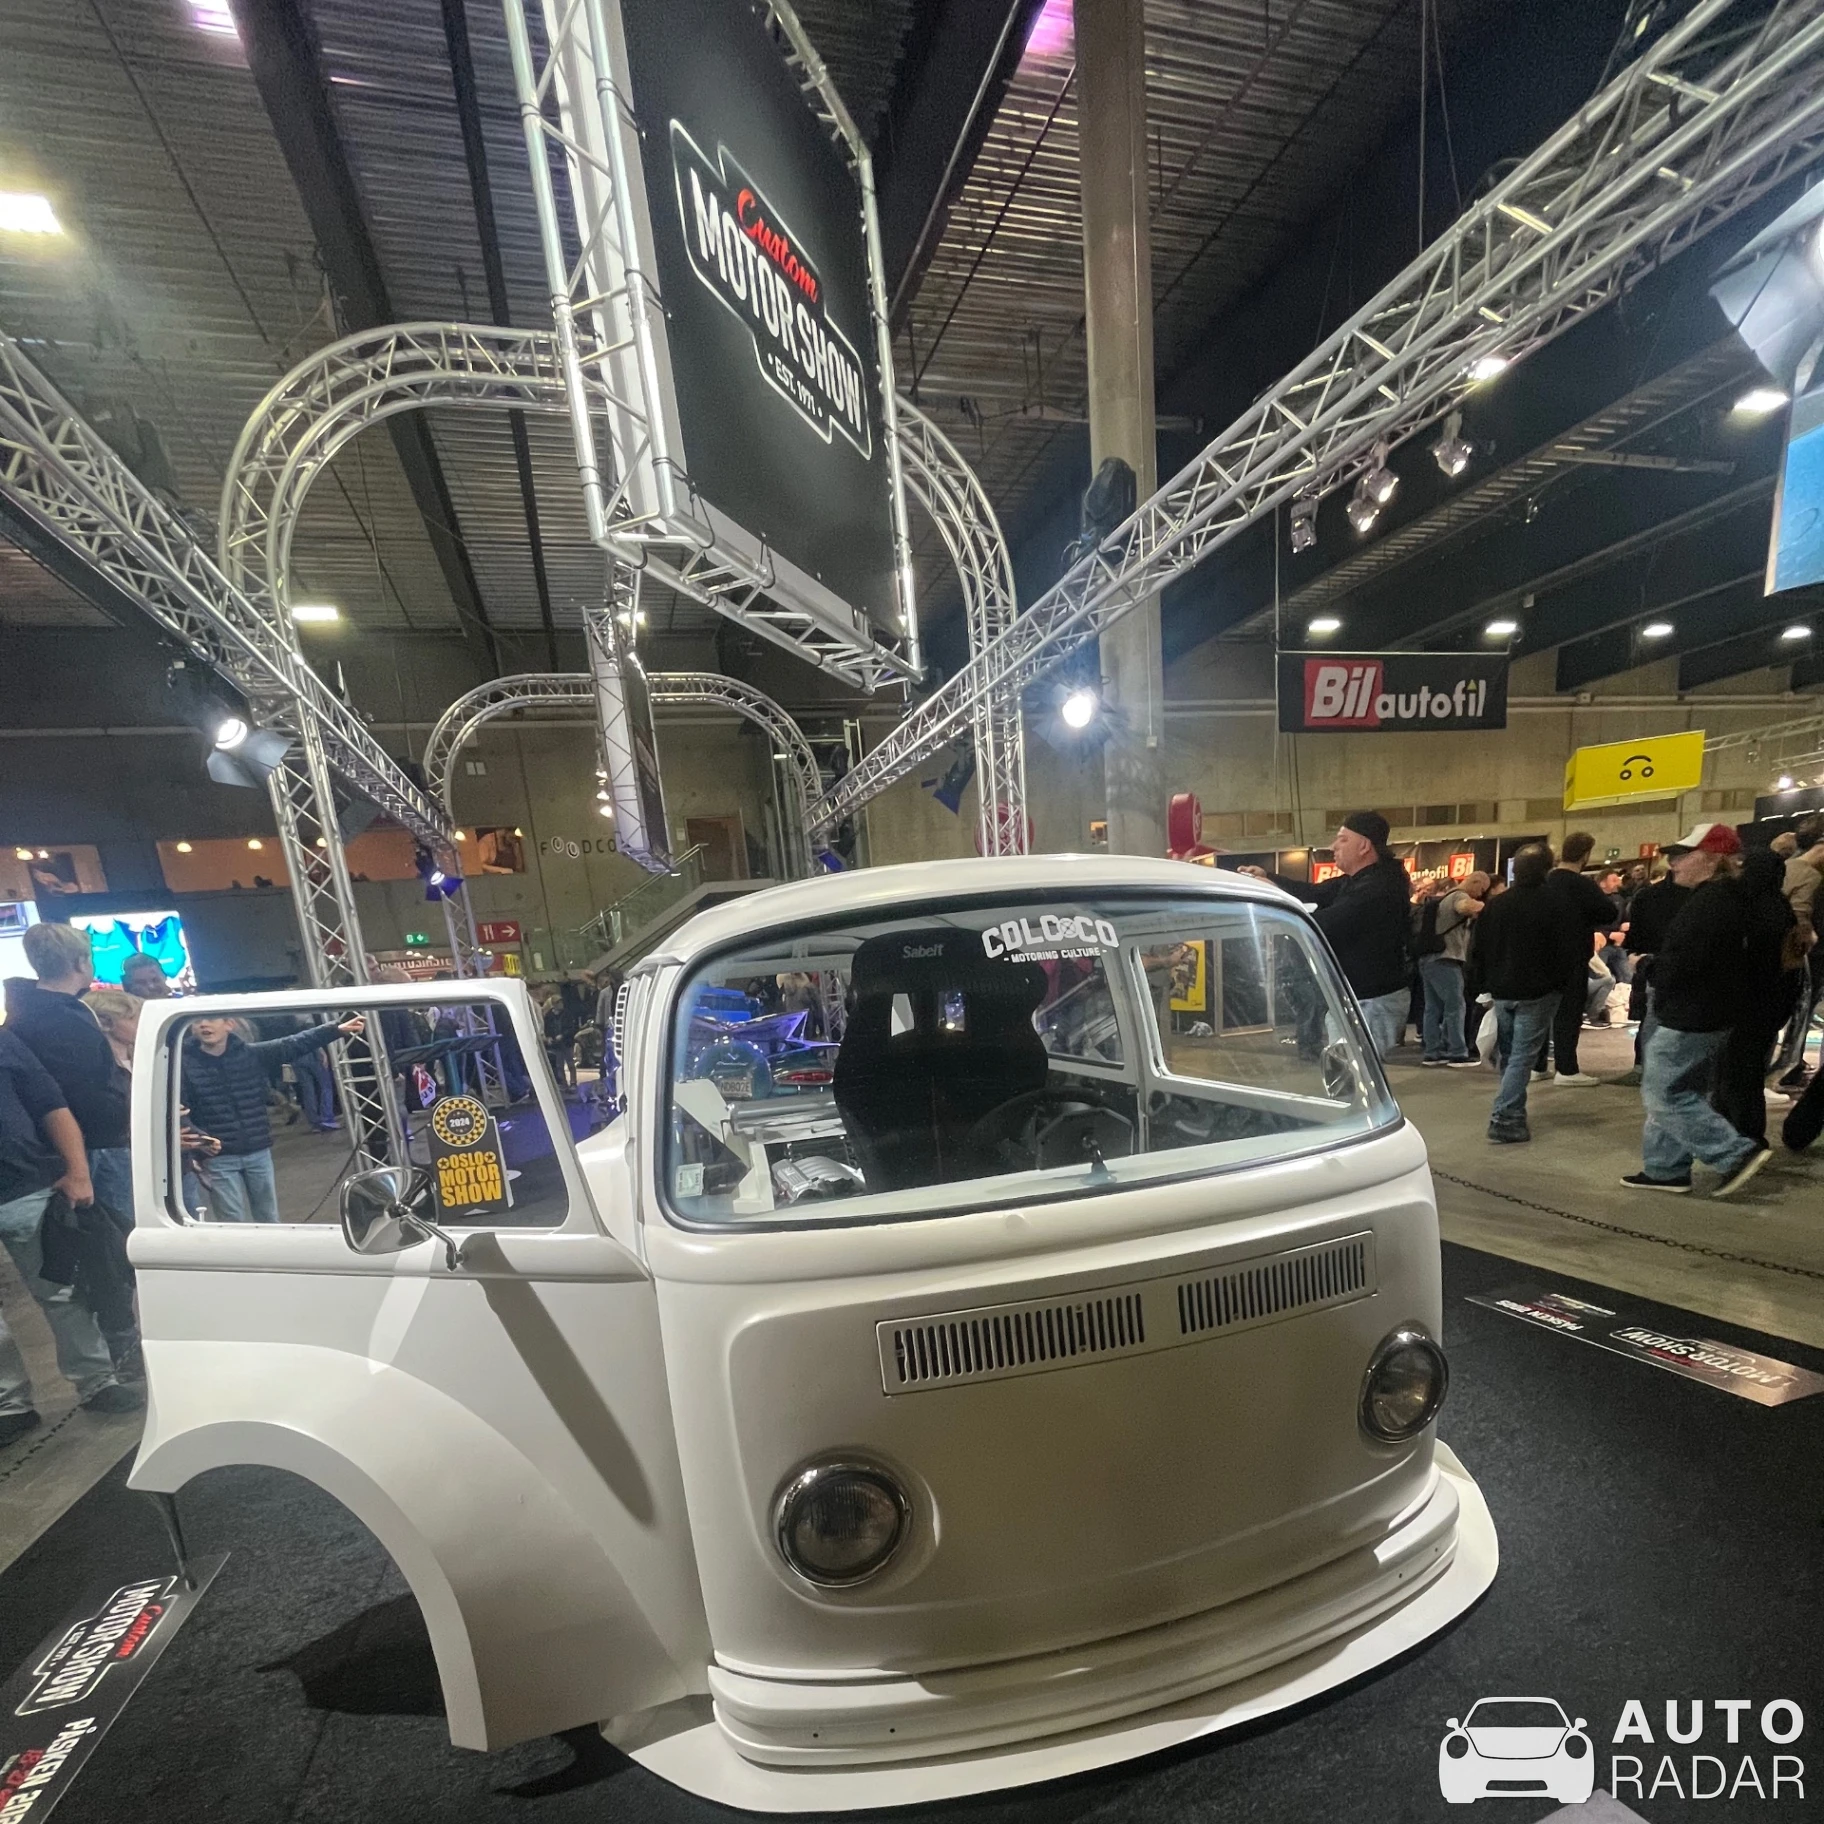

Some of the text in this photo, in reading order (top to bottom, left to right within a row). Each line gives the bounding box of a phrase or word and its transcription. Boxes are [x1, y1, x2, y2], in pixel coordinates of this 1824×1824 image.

[736, 187, 819, 304] Custom
[689, 167, 863, 433] MOTOR SHOW
[774, 355, 817, 416] EST. 1971
[1311, 666, 1486, 719] Bil autofil
[903, 943, 944, 959] Sabelt
[1011, 947, 1101, 963] MOTORING CULTURE
[449, 1117, 470, 1128] 2024
[438, 1163, 501, 1187] MOTOR
[449, 1151, 485, 1169] OSLO
[441, 1179, 502, 1207] SHOW
[35, 1583, 162, 1703] MOTOR SHOW
[18, 1717, 98, 1789] PÅSKEN
